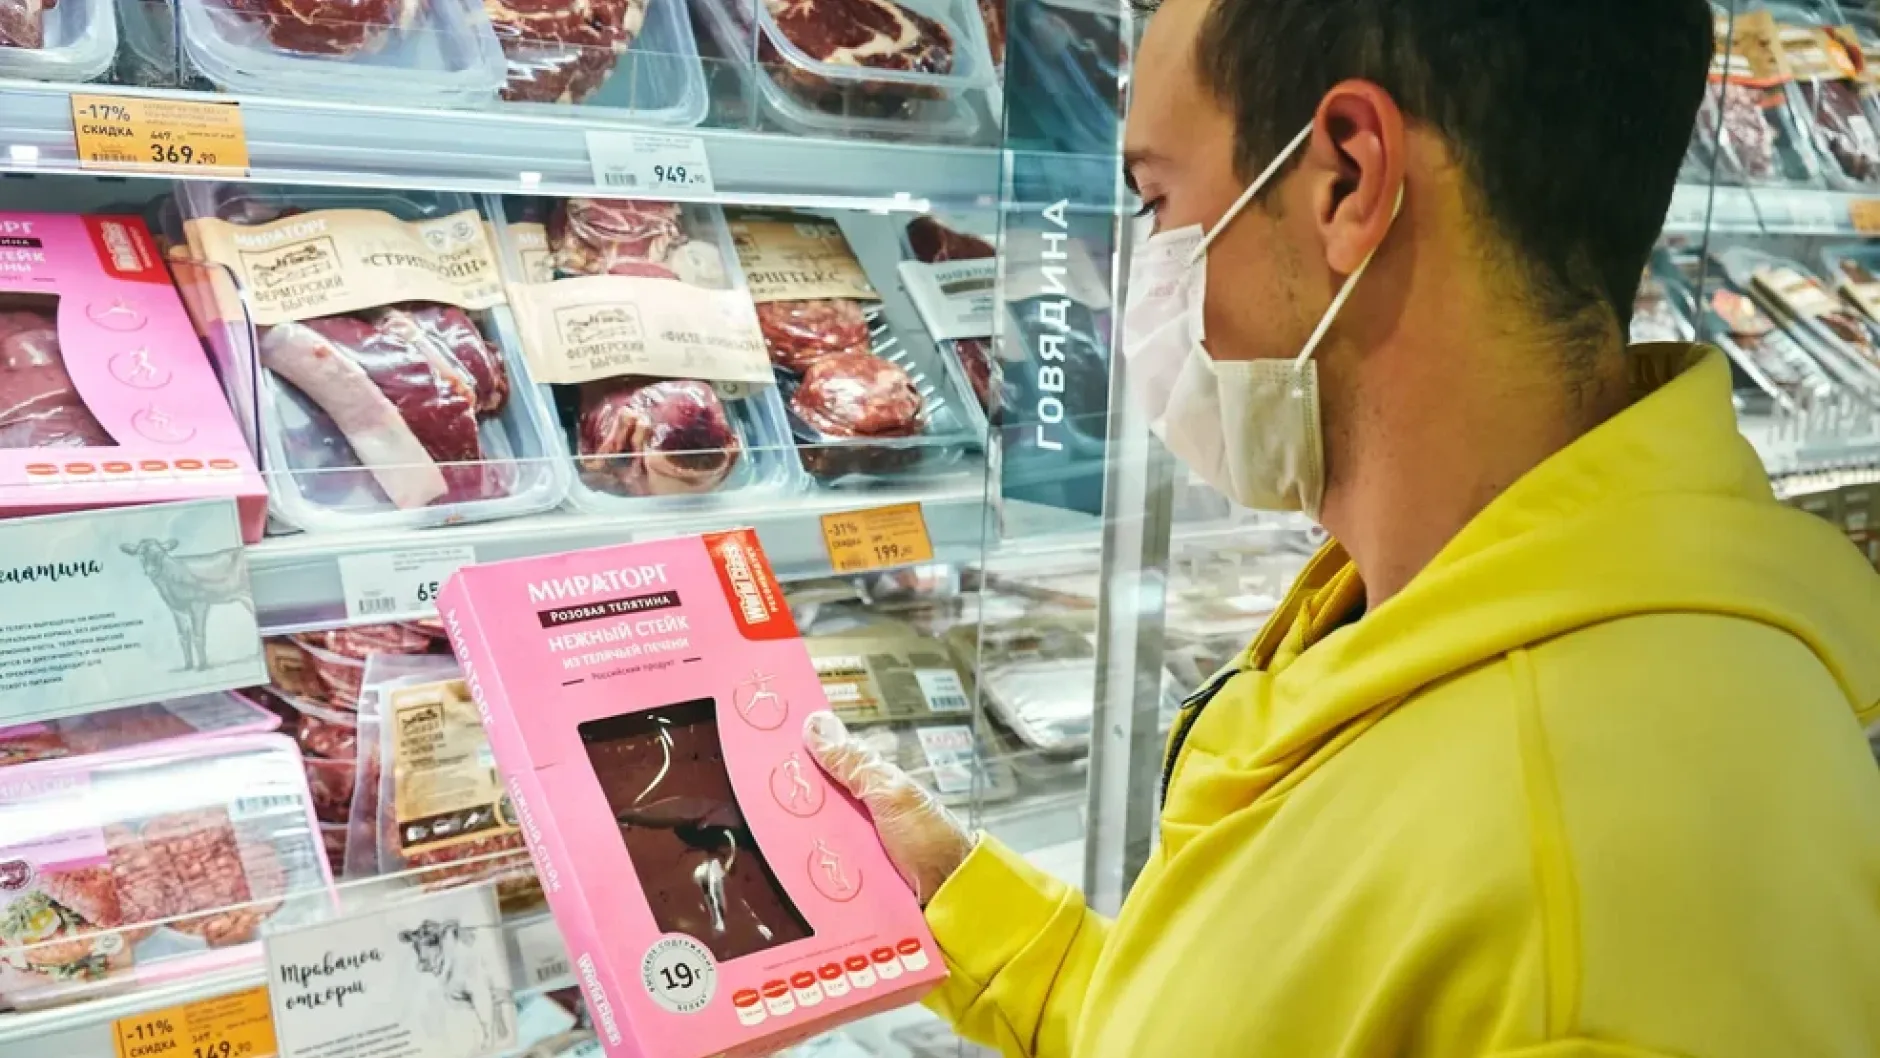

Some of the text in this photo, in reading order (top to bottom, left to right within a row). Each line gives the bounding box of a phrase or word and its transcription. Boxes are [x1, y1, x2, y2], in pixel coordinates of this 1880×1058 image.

[80, 104, 131, 121] -17%
[82, 125, 134, 137] СКИДКА
[0, 221, 33, 235] РГ
[233, 219, 328, 246] МИРАТОРГ
[254, 275, 344, 301] ФЕРМЕРСКИЙ
[281, 295, 329, 312] БЫЧОК
[1036, 197, 1071, 451] ГОВЯДИНА
[567, 341, 644, 359] ФЕРМЕРСКИЙ
[527, 563, 669, 604] МИРАТОРГ
[550, 595, 671, 623] РОЗОВАЯ ТЕЛЯТИНА
[548, 615, 690, 652] НЕЖНЫЙ СТЕЙК
[562, 637, 690, 670] ИЗ ТЕЛЯЧЬЕЙ ПЕЧЕНИ
[447, 608, 494, 726] МИРАТОРГ
[660, 962, 694, 991] 19
[126, 1018, 173, 1041] -11%
[130, 1040, 177, 1058] СКИДКА
